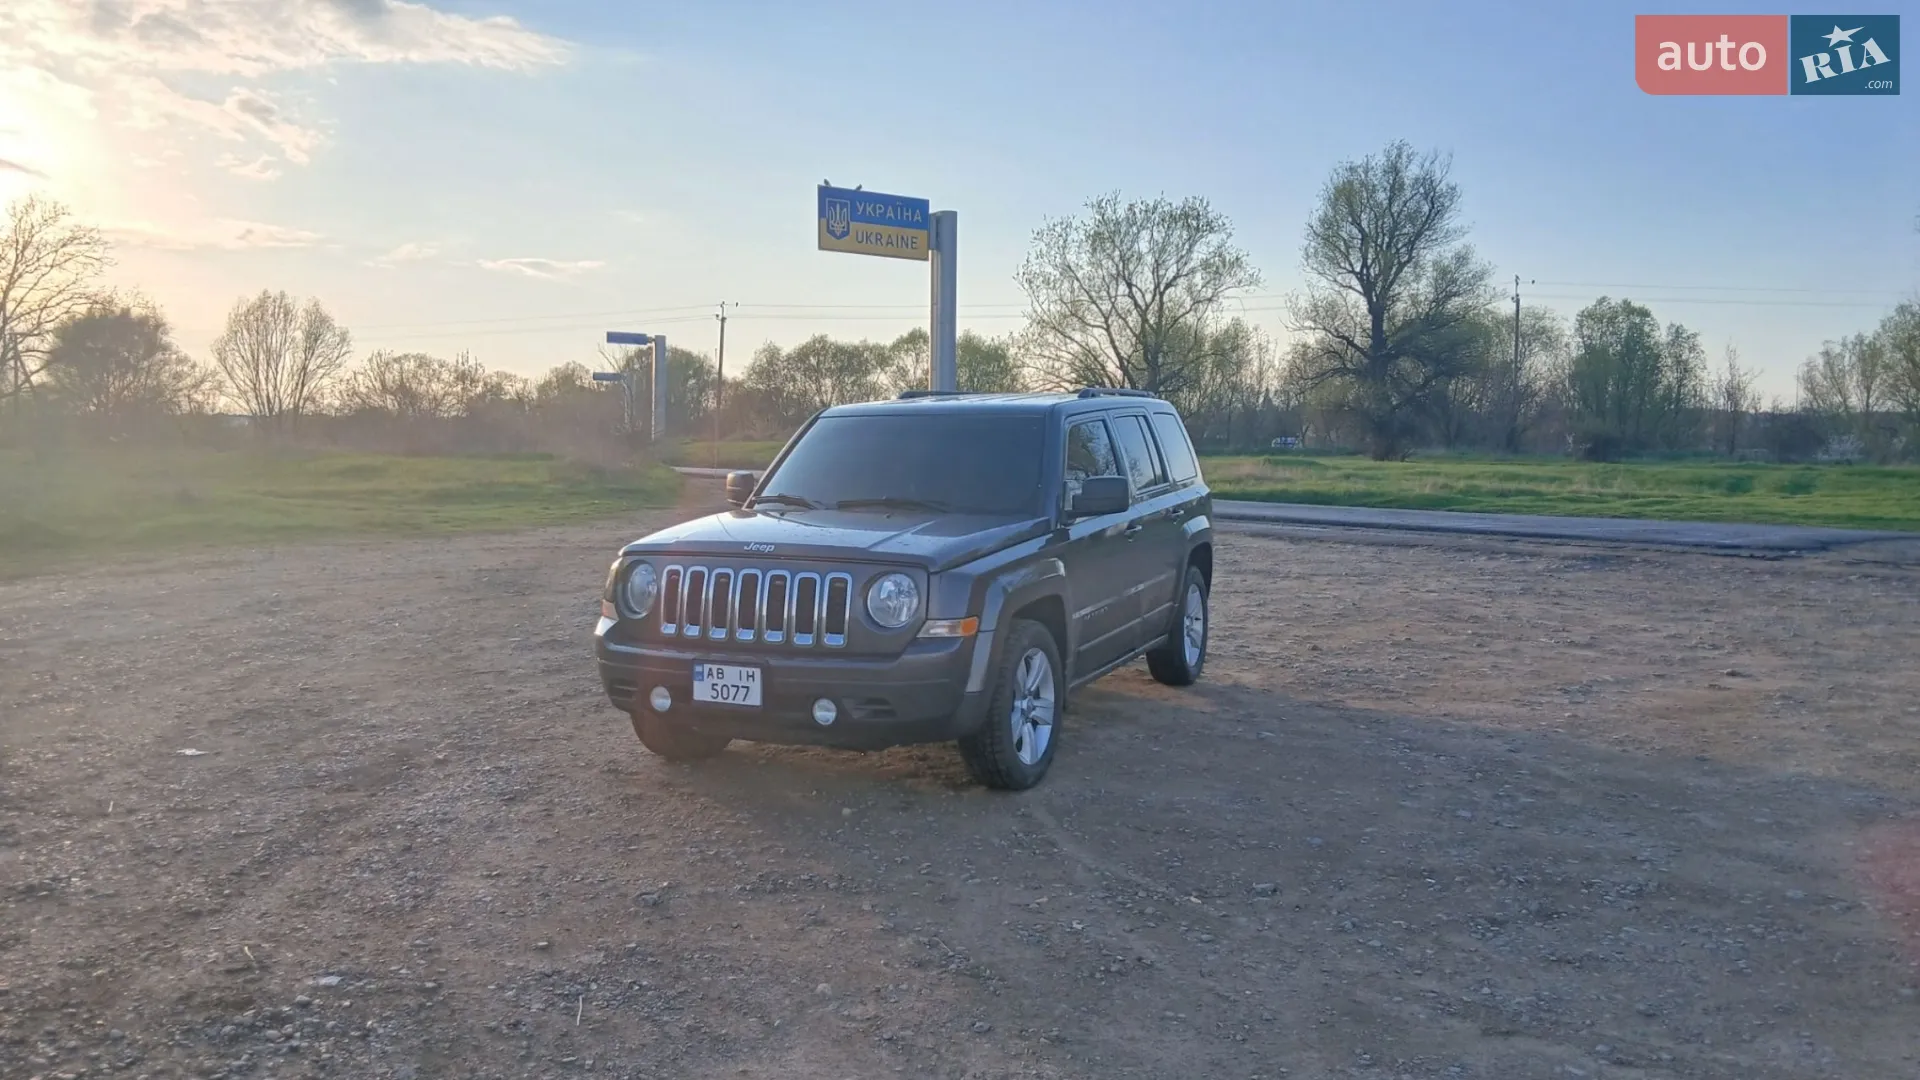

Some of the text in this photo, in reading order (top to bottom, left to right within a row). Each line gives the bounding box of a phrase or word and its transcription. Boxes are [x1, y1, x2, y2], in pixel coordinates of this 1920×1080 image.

[855, 201, 922, 222] УКРАЇНА
[855, 230, 918, 249] UKRAINE
[744, 542, 775, 553] Jeep
[707, 667, 724, 680] AB
[711, 683, 750, 702] 5077
